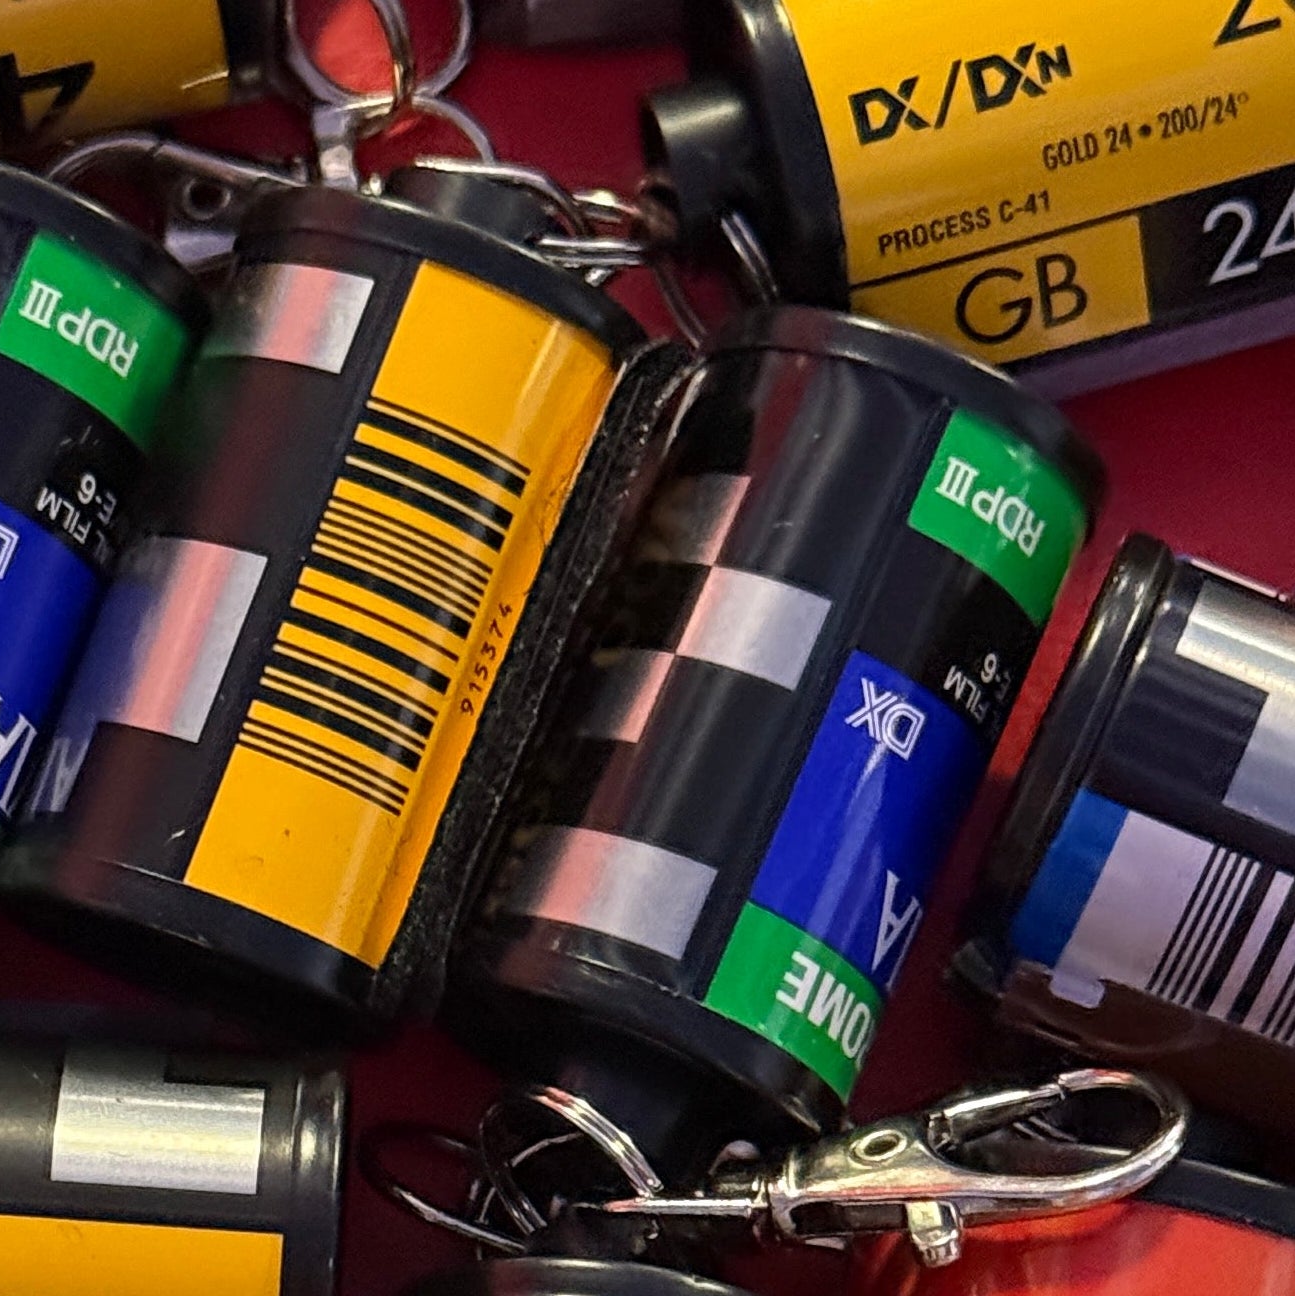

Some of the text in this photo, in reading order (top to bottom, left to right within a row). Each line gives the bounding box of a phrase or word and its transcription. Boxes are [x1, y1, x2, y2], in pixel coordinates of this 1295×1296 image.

[1041, 133, 1100, 172] GOLD
[1104, 123, 1133, 154] 24
[877, 190, 1051, 258] PROCESS C-41
[954, 252, 1089, 346] GB
[57, 307, 140, 378] RDP
[35, 486, 92, 545] FILM
[970, 485, 1047, 559] RDP
[458, 601, 513, 717] 915374
[843, 677, 927, 761] DX
[775, 950, 876, 1073] OME
